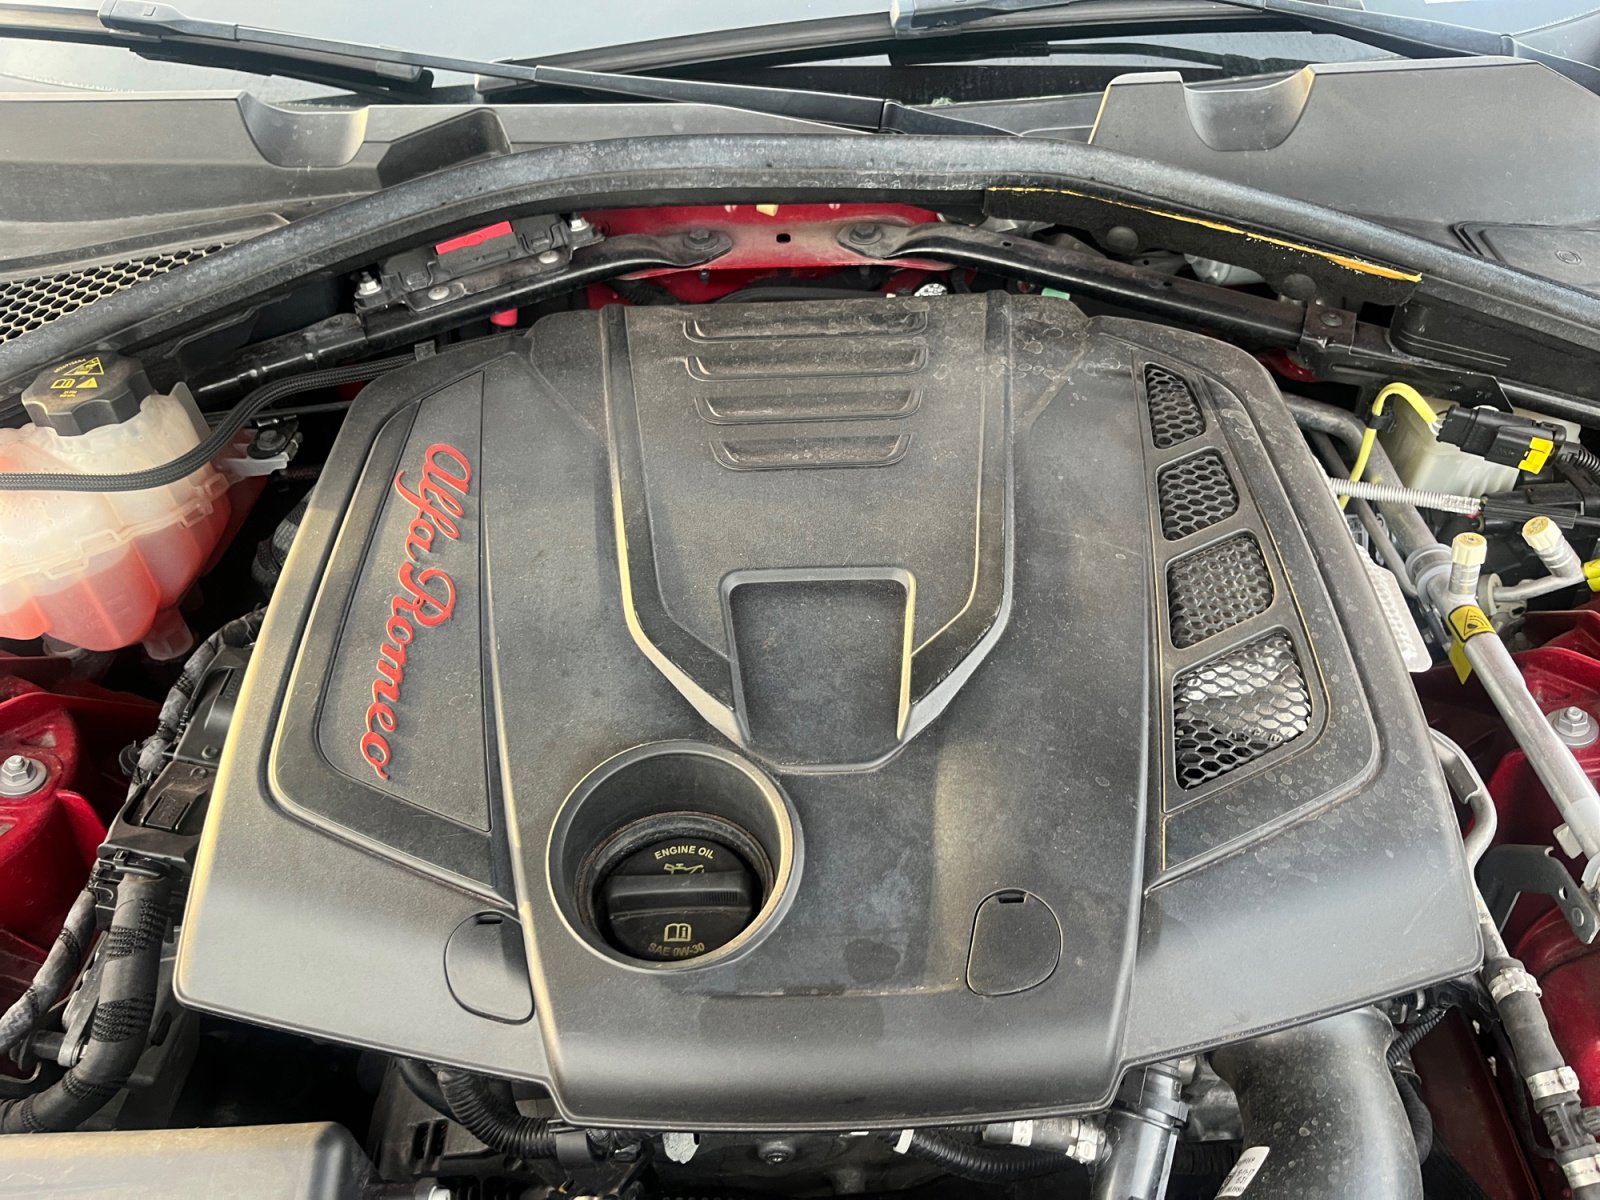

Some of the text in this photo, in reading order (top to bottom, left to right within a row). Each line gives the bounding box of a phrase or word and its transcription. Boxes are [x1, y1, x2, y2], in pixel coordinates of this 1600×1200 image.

[360, 443, 472, 780] Alfa Romeo
[654, 845, 714, 859] ENGINE OIL
[649, 943, 704, 956] SAE 0W-30
